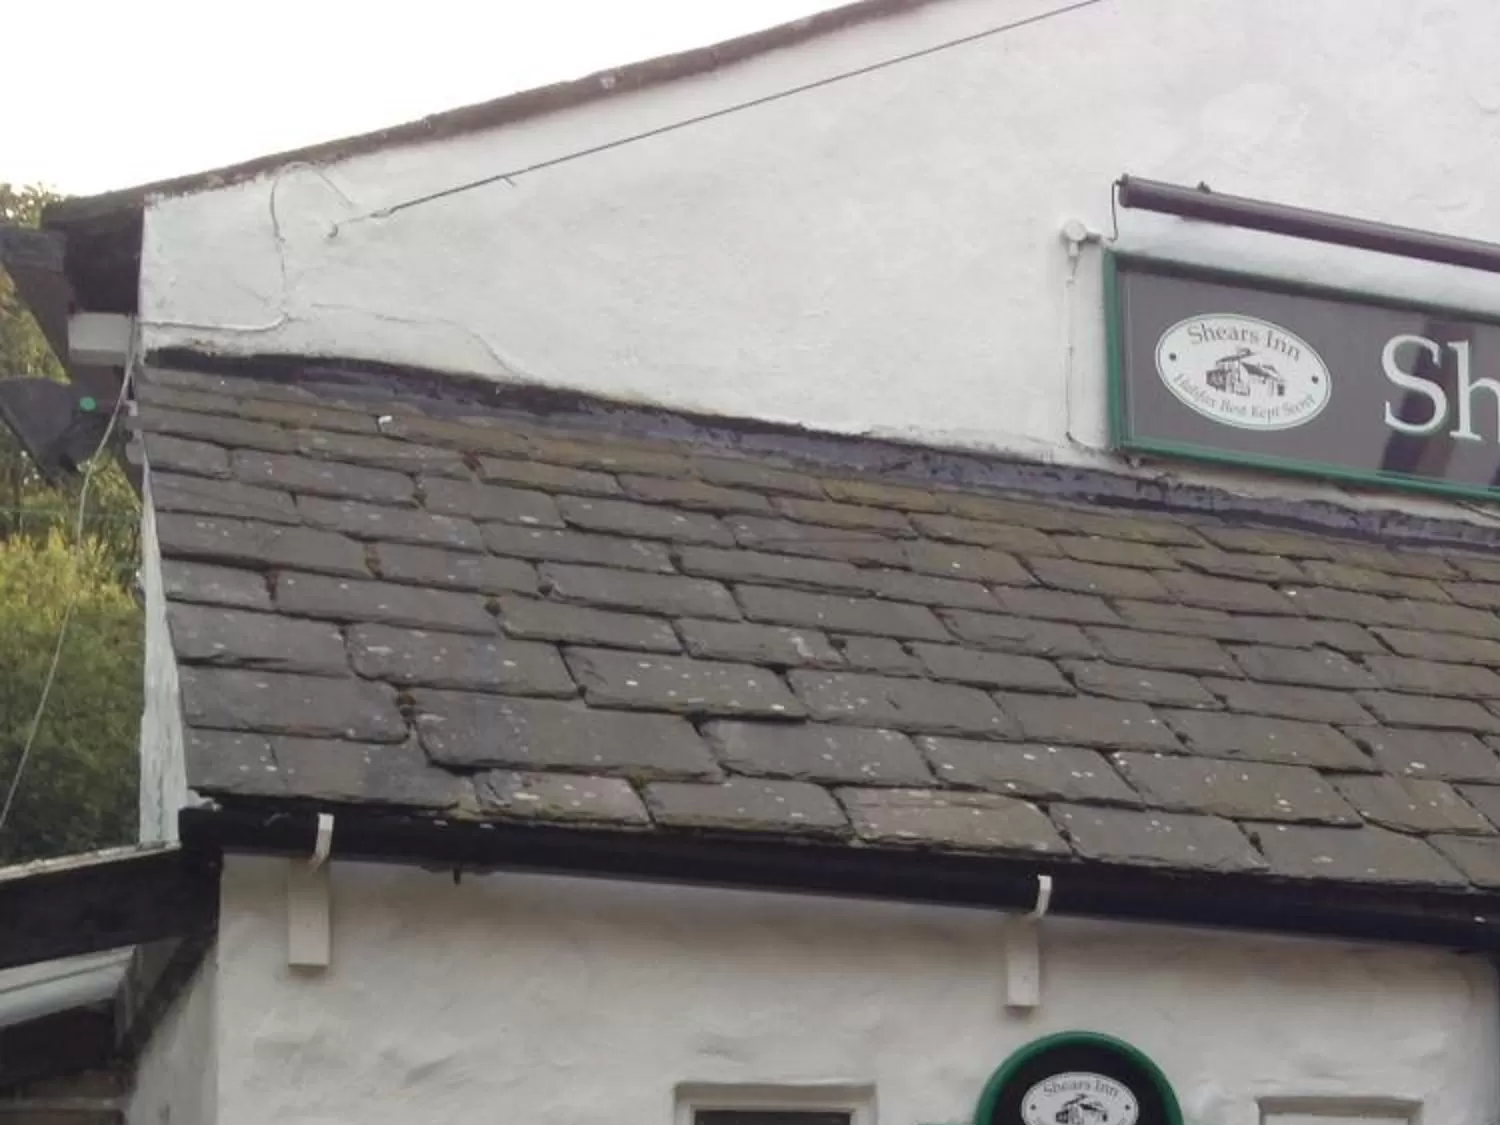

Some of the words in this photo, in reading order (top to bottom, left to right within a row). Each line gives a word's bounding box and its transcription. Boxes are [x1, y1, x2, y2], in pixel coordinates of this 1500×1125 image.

[1188, 322, 1260, 346] Shears
[1267, 330, 1301, 361] Inn
[1043, 1079, 1091, 1097] Shears
[1096, 1079, 1120, 1097] Inn
